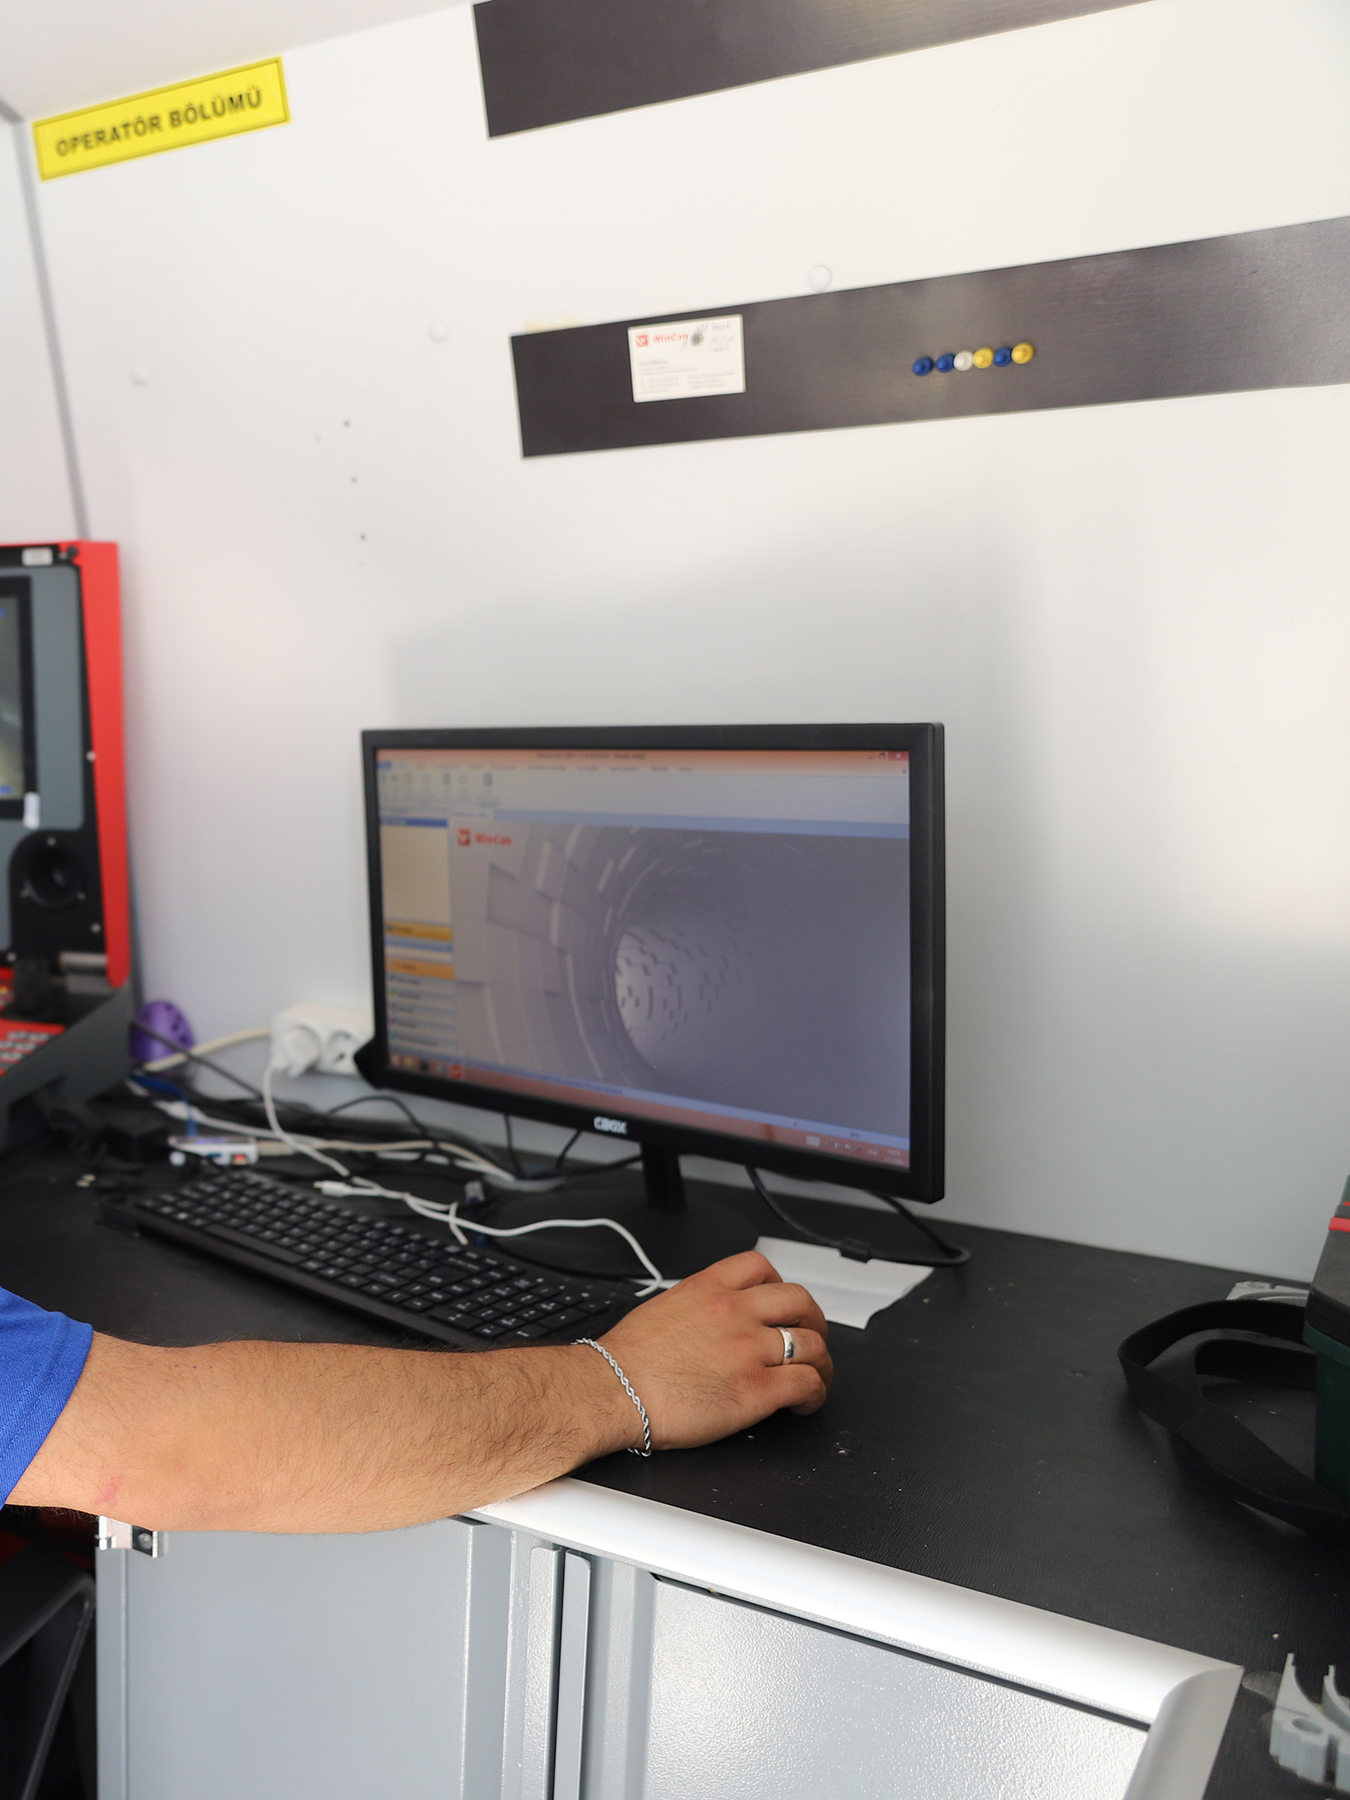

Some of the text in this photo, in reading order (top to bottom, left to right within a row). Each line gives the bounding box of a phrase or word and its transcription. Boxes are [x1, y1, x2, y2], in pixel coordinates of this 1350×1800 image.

[56, 86, 262, 157] OPERATÖR BÖLÜMÜ
[475, 834, 512, 846] WinCan
